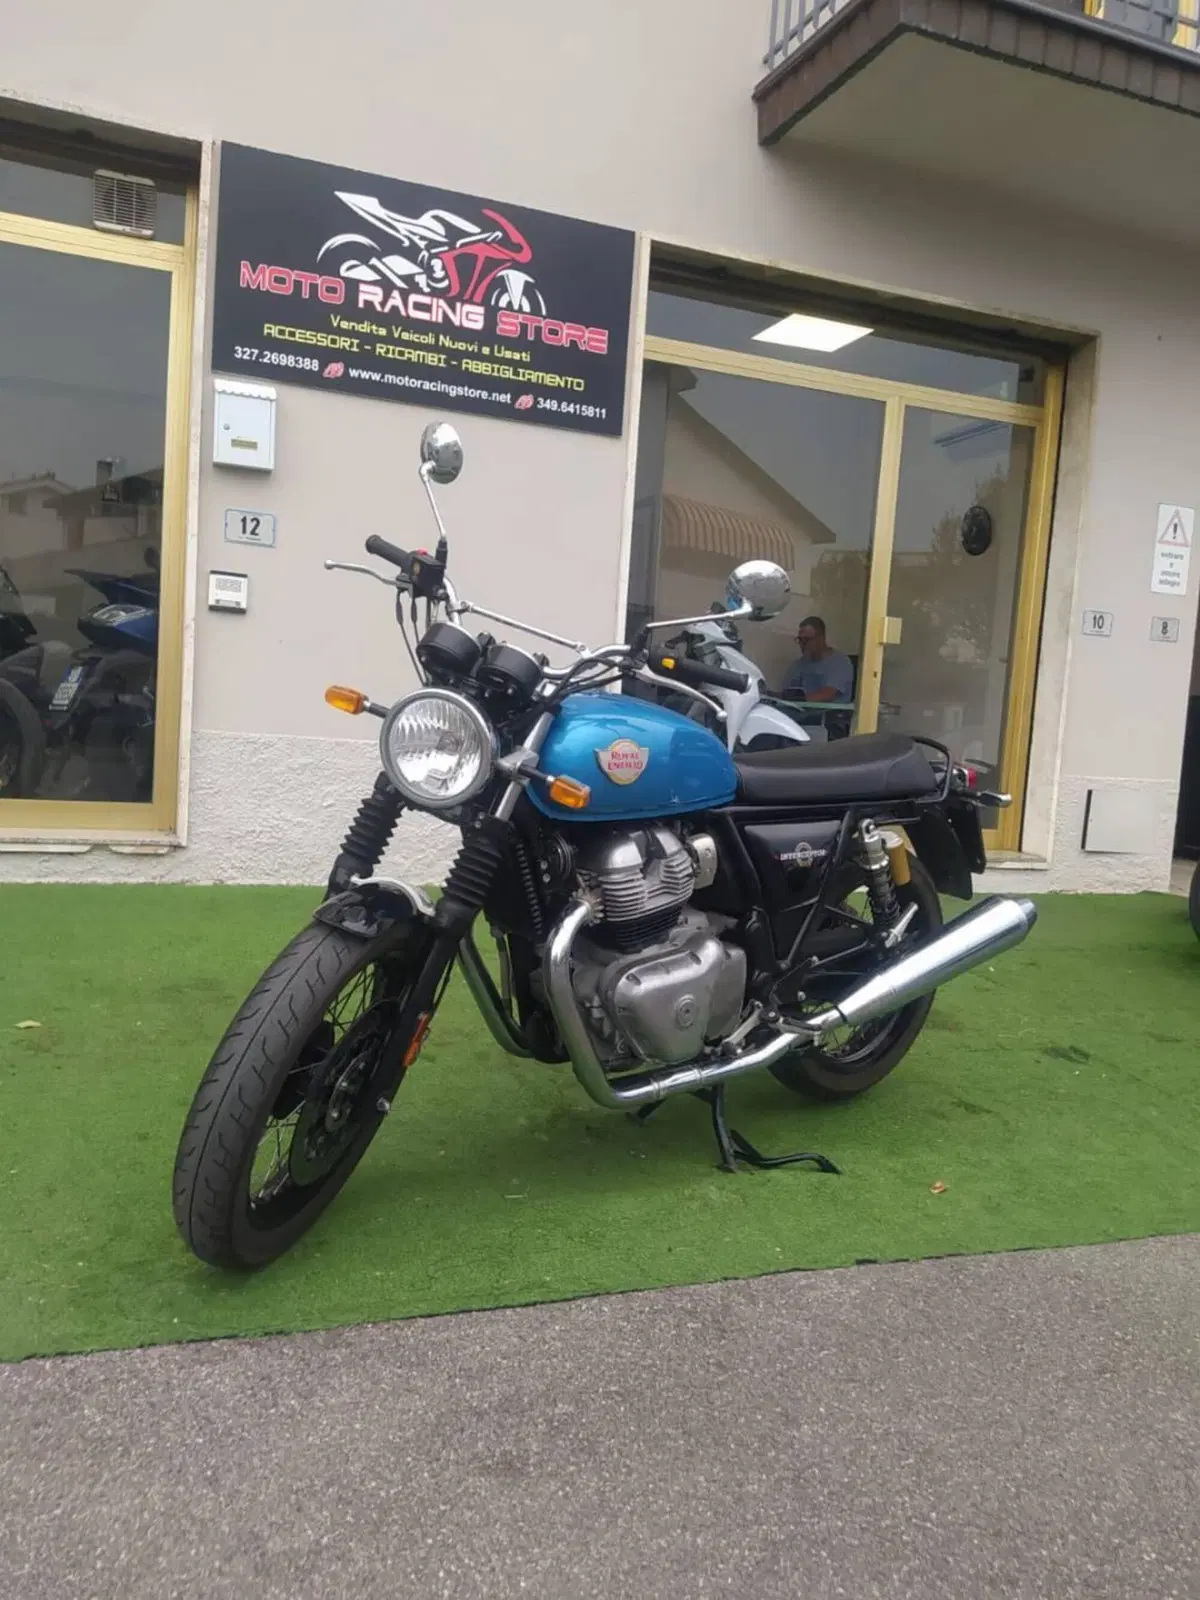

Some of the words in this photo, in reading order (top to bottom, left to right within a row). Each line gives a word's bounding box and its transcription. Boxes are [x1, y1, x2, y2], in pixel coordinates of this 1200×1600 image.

[240, 260, 346, 305] MOTO
[358, 283, 486, 331] RACING
[496, 310, 609, 355] STORE
[263, 323, 360, 352] ACCESSORI
[375, 343, 447, 367] RICAMBI
[461, 358, 585, 392] ABBIGLIAMENTO
[330, 313, 387, 337] Vendita
[392, 325, 435, 345] Veicoli
[439, 333, 479, 353] Nuovi
[481, 346, 491, 355] e
[493, 344, 531, 362] Usati
[234, 346, 320, 372] 327.2698388
[348, 366, 512, 404] www.motoracingstore.net
[536, 397, 607, 420] 349.6415811
[240, 515, 261, 537] 12
[1092, 614, 1105, 630] 10
[1161, 621, 1169, 636] 8
